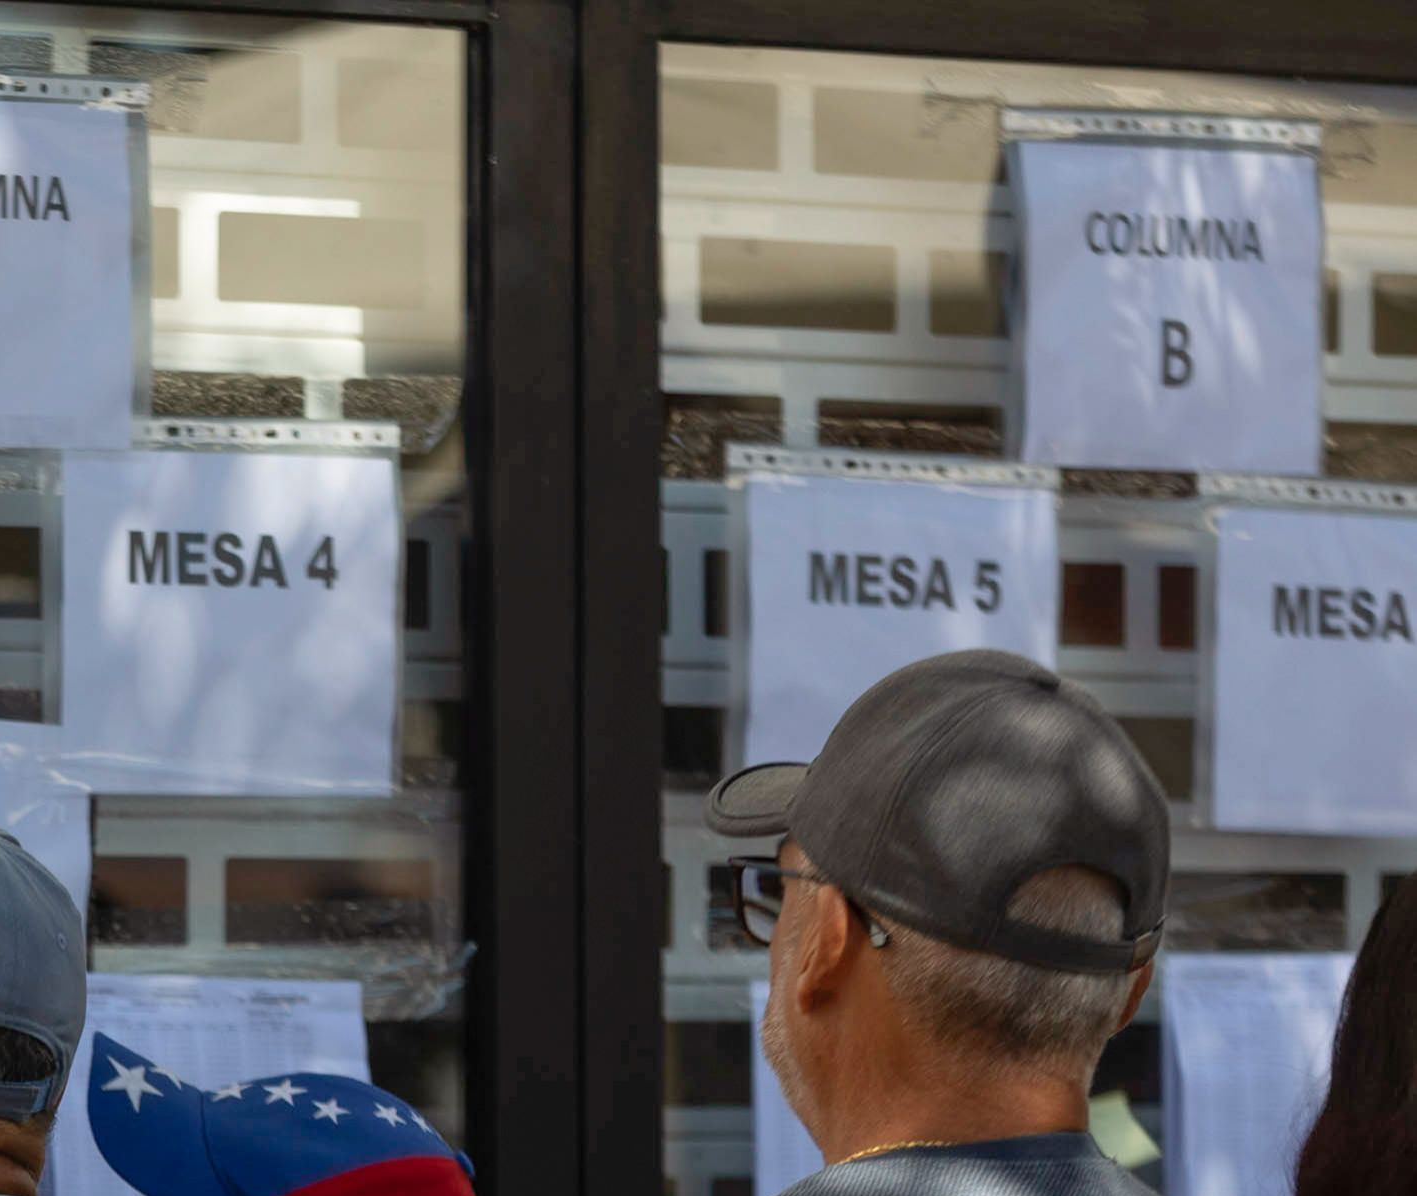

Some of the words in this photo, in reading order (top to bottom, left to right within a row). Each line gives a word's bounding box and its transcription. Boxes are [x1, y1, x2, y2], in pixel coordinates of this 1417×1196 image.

[1085, 211, 1265, 262] COLUMNA
[1160, 319, 1195, 390] B
[128, 530, 289, 589] MESA
[305, 536, 339, 591] 4
[808, 551, 956, 611] MESA
[974, 560, 1003, 614] 5
[1272, 584, 1413, 642] MESA
